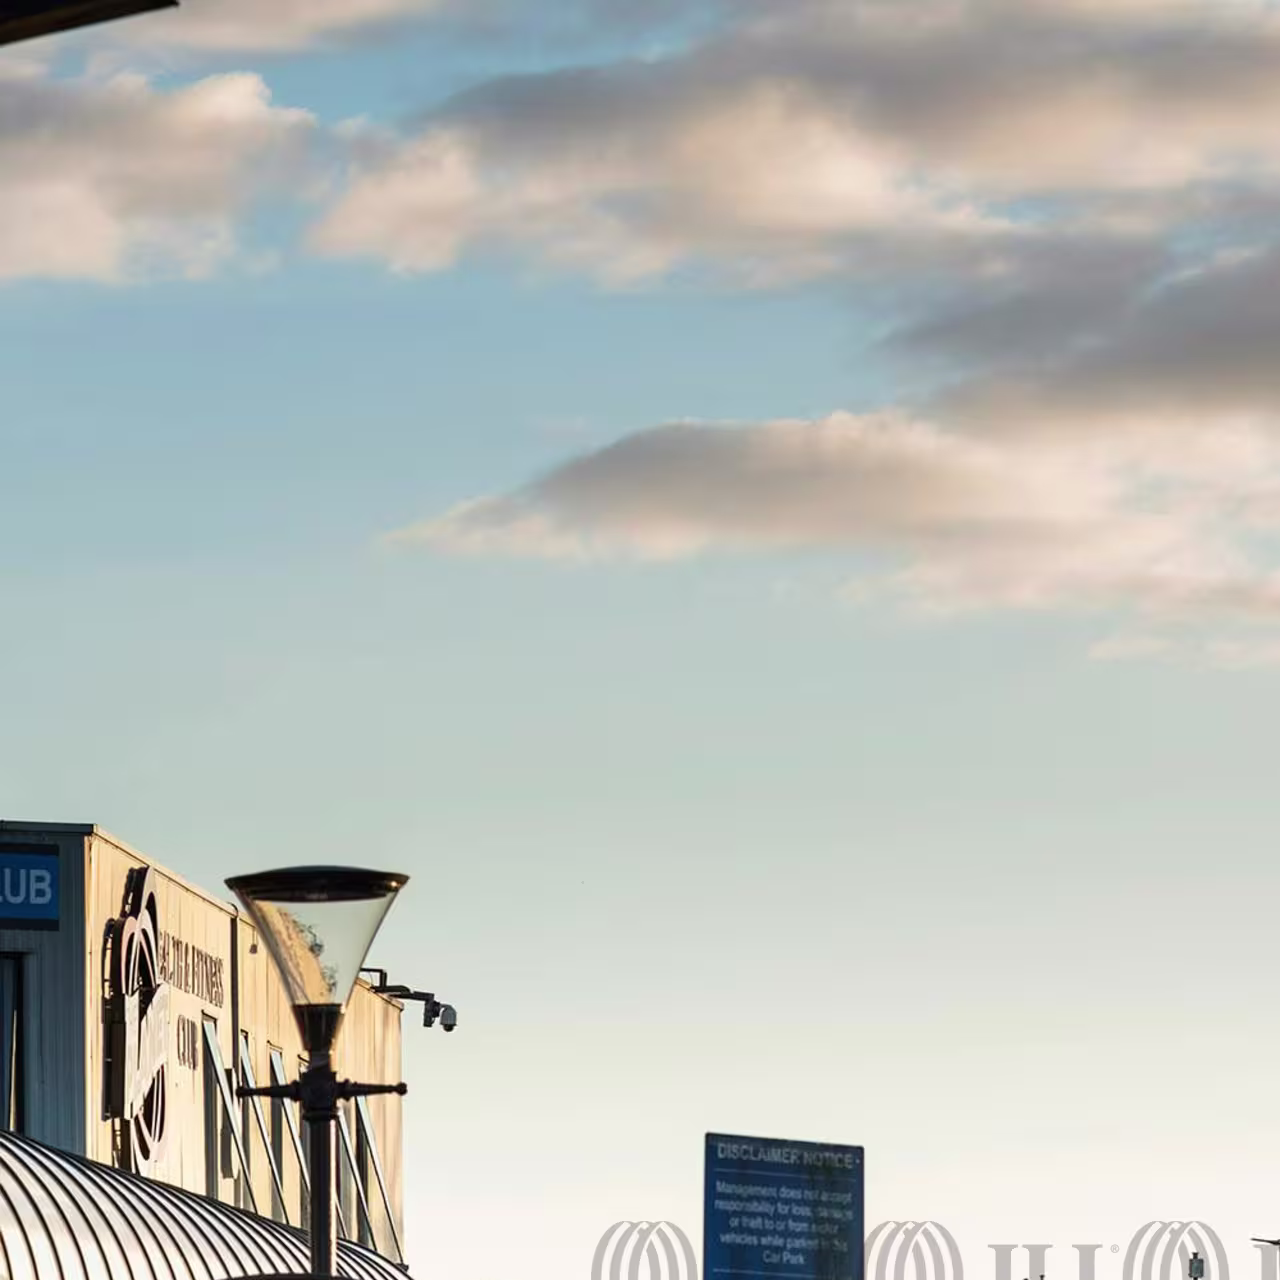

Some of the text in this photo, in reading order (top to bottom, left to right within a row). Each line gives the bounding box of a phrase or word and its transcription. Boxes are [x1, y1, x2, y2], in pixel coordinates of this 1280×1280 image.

[0, 867, 52, 904] UB
[177, 1014, 198, 1071] CLUB
[717, 1142, 854, 1169] DISCLAIMER NOTICE
